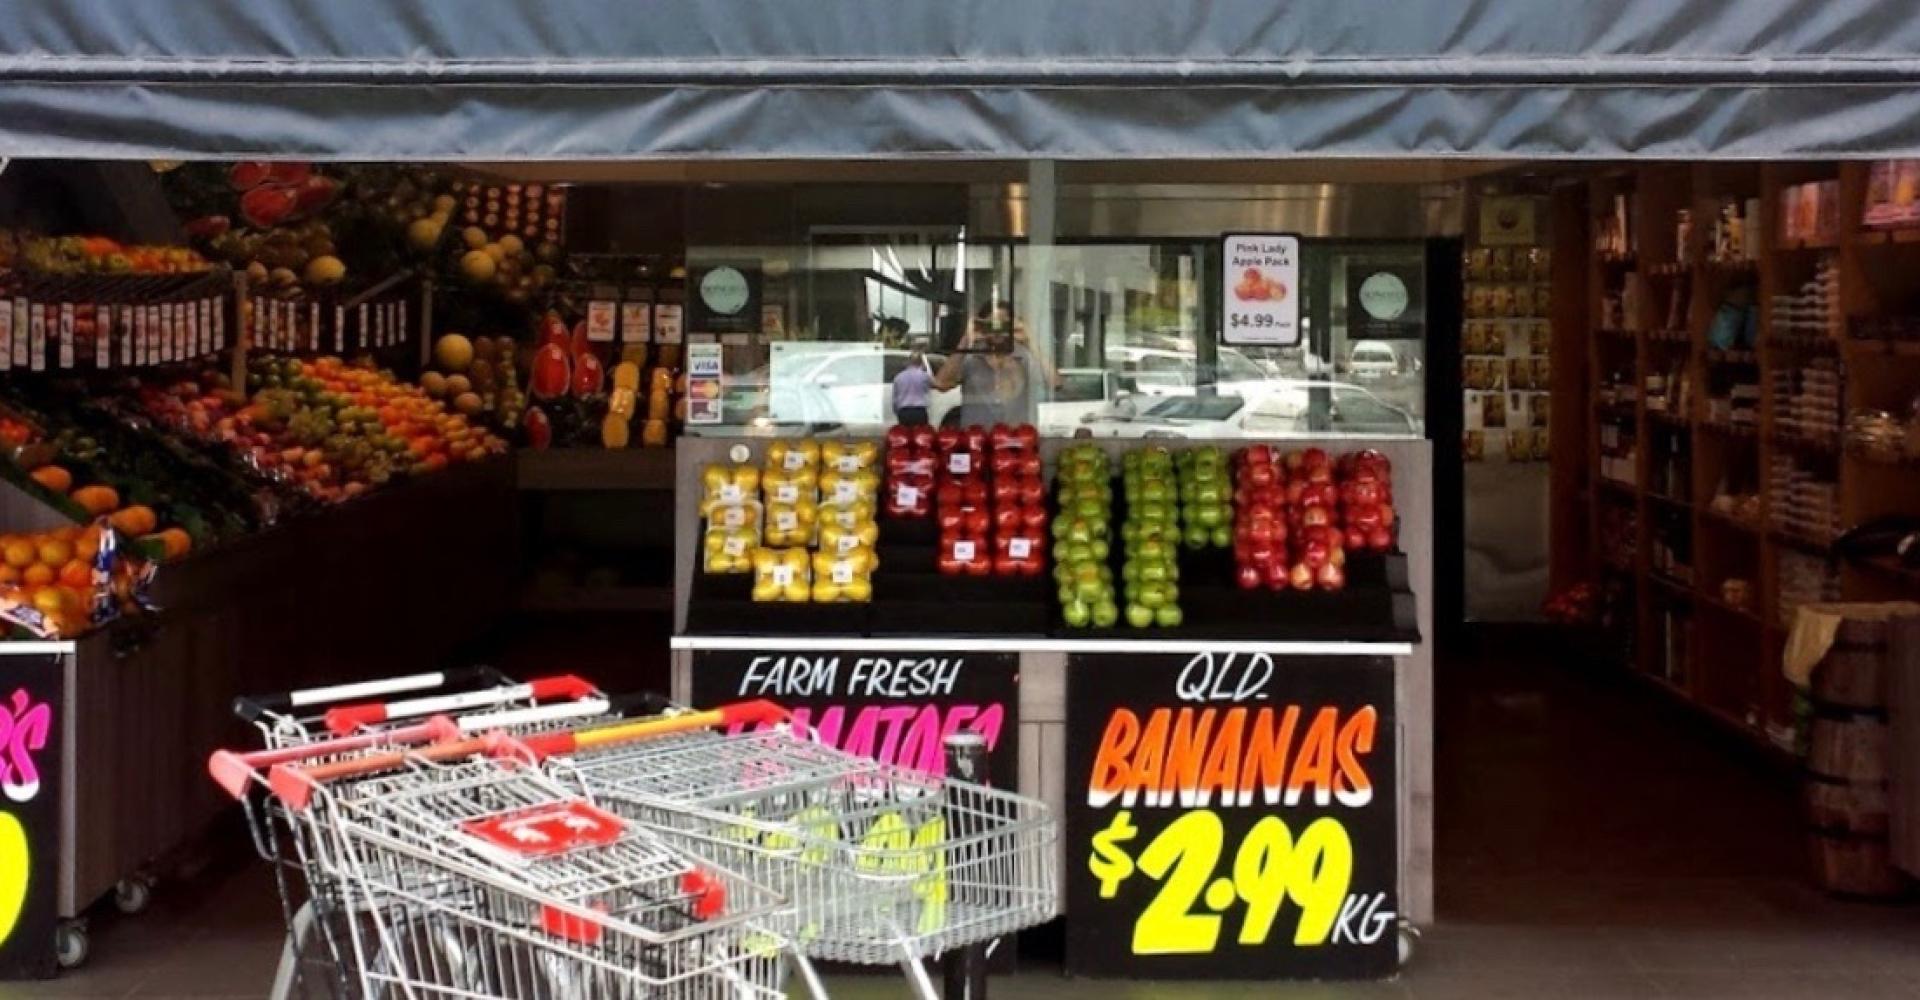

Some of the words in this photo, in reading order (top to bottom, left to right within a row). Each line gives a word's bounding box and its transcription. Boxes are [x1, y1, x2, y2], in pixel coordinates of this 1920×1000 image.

[1236, 244, 1258, 253] Pink
[1262, 244, 1287, 255] Lady
[1232, 256, 1262, 267] Apple
[1264, 256, 1290, 266] Pack
[1230, 313, 1273, 328] $4.99
[694, 359, 719, 371] VISA
[738, 656, 840, 697] FARM
[847, 657, 964, 698] FRESH
[1087, 704, 1377, 808] BANANAS
[1088, 809, 1353, 955] $2.99
[1330, 892, 1396, 945] KG
